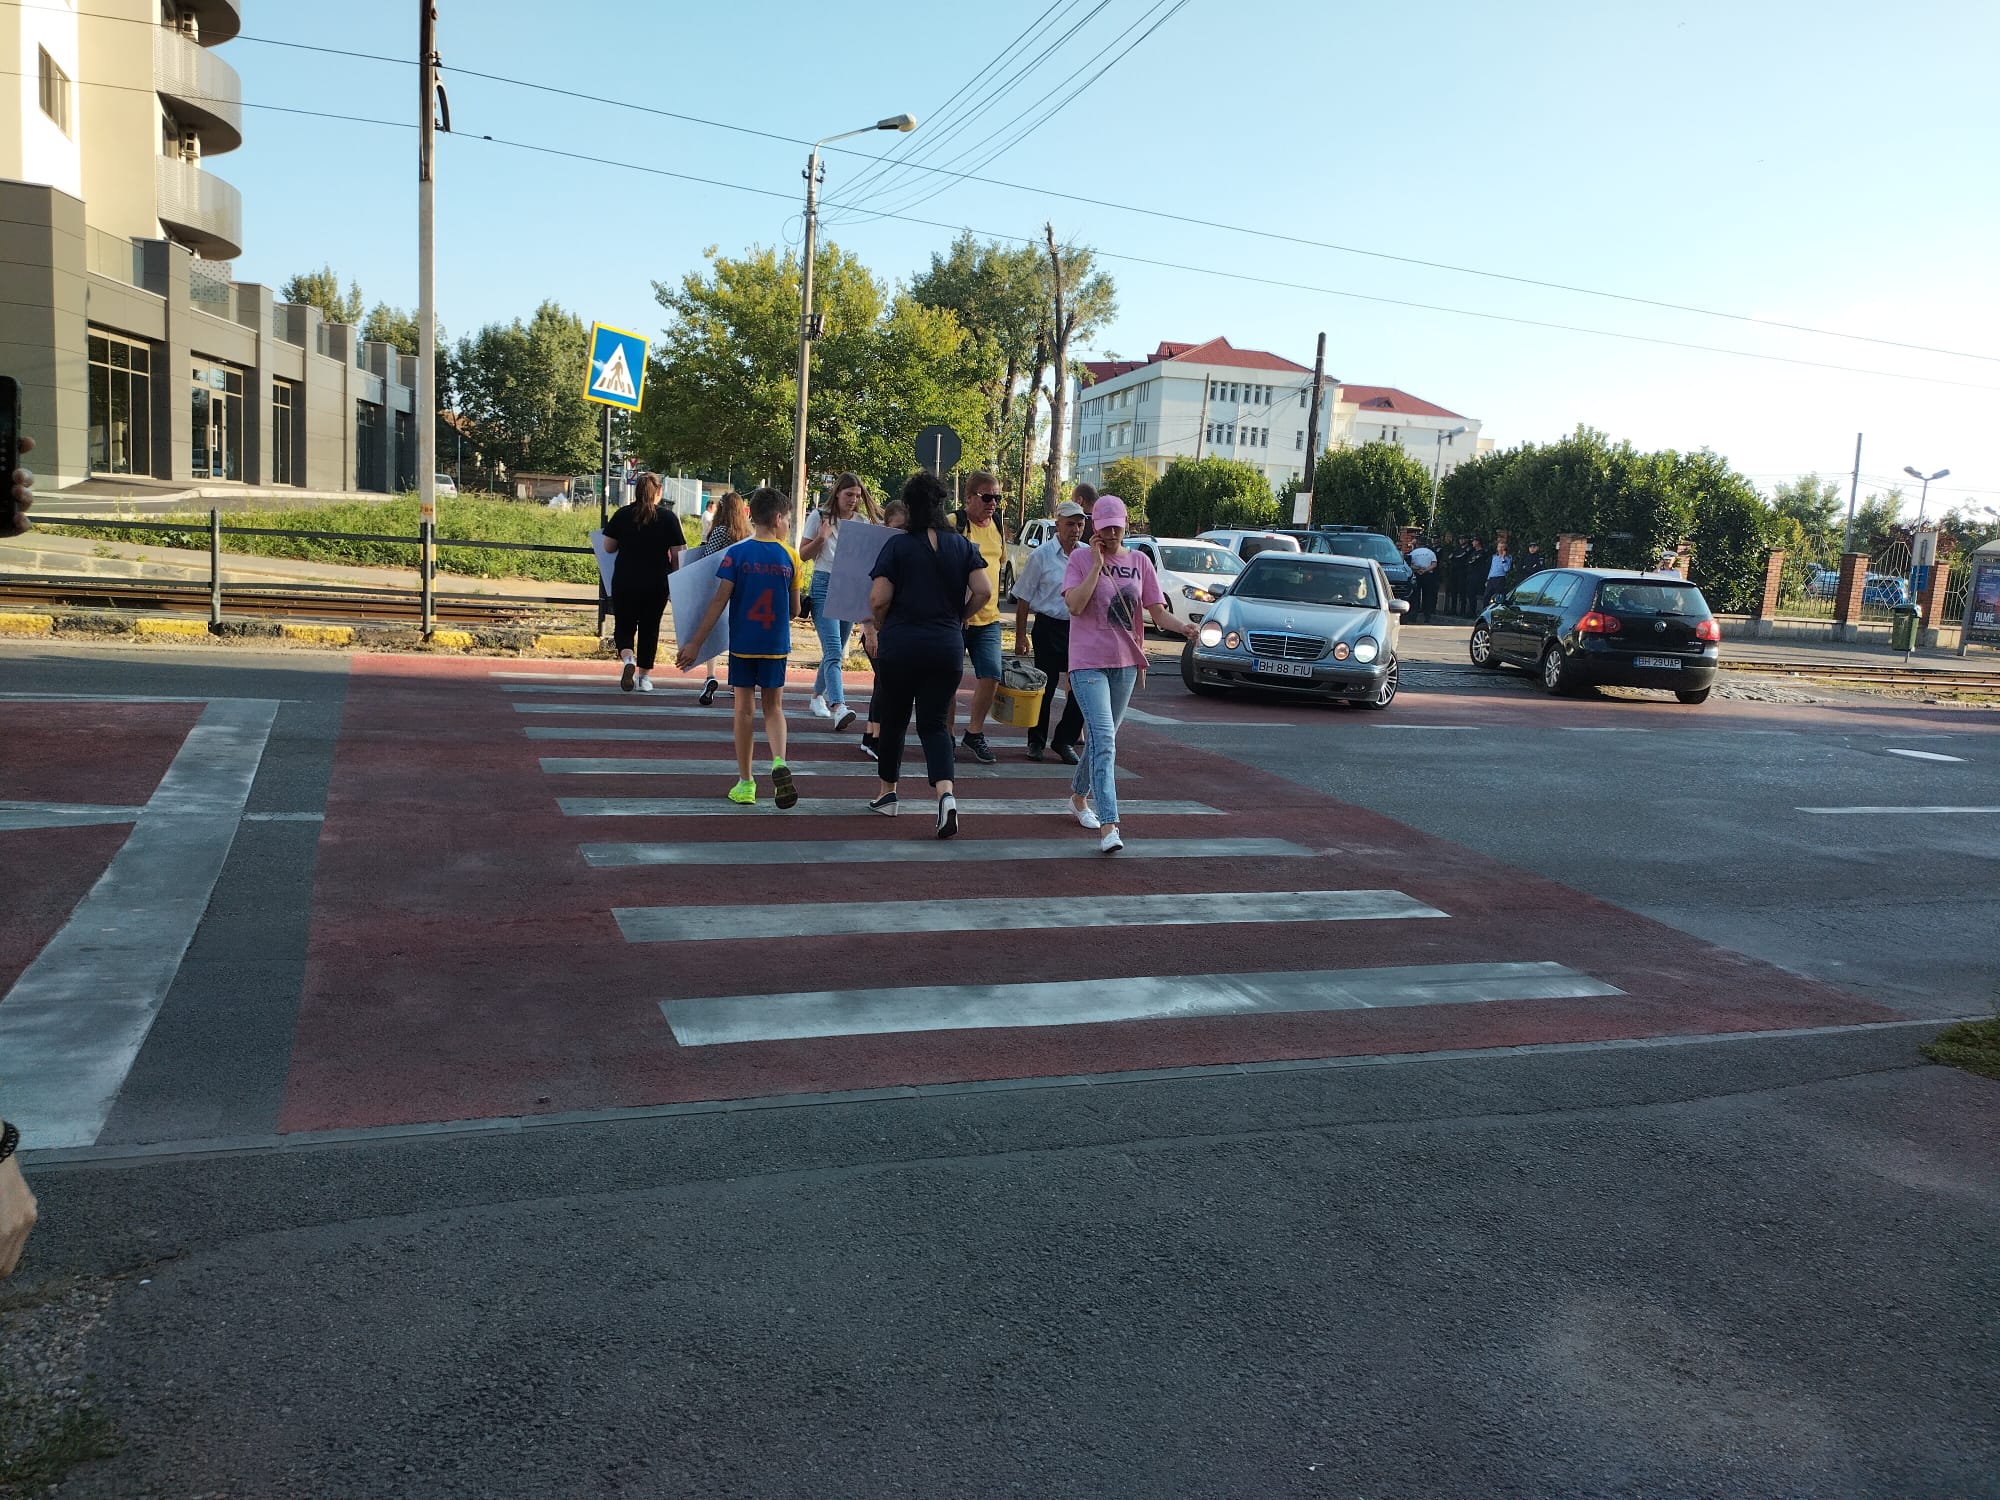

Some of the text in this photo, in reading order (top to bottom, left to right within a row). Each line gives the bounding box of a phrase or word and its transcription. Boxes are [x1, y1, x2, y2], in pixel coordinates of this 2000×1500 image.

[1099, 565, 1141, 580] NASA
[748, 588, 775, 629] 4
[1974, 611, 1995, 623] FILME
[1259, 661, 1311, 676] BH 88 FIU
